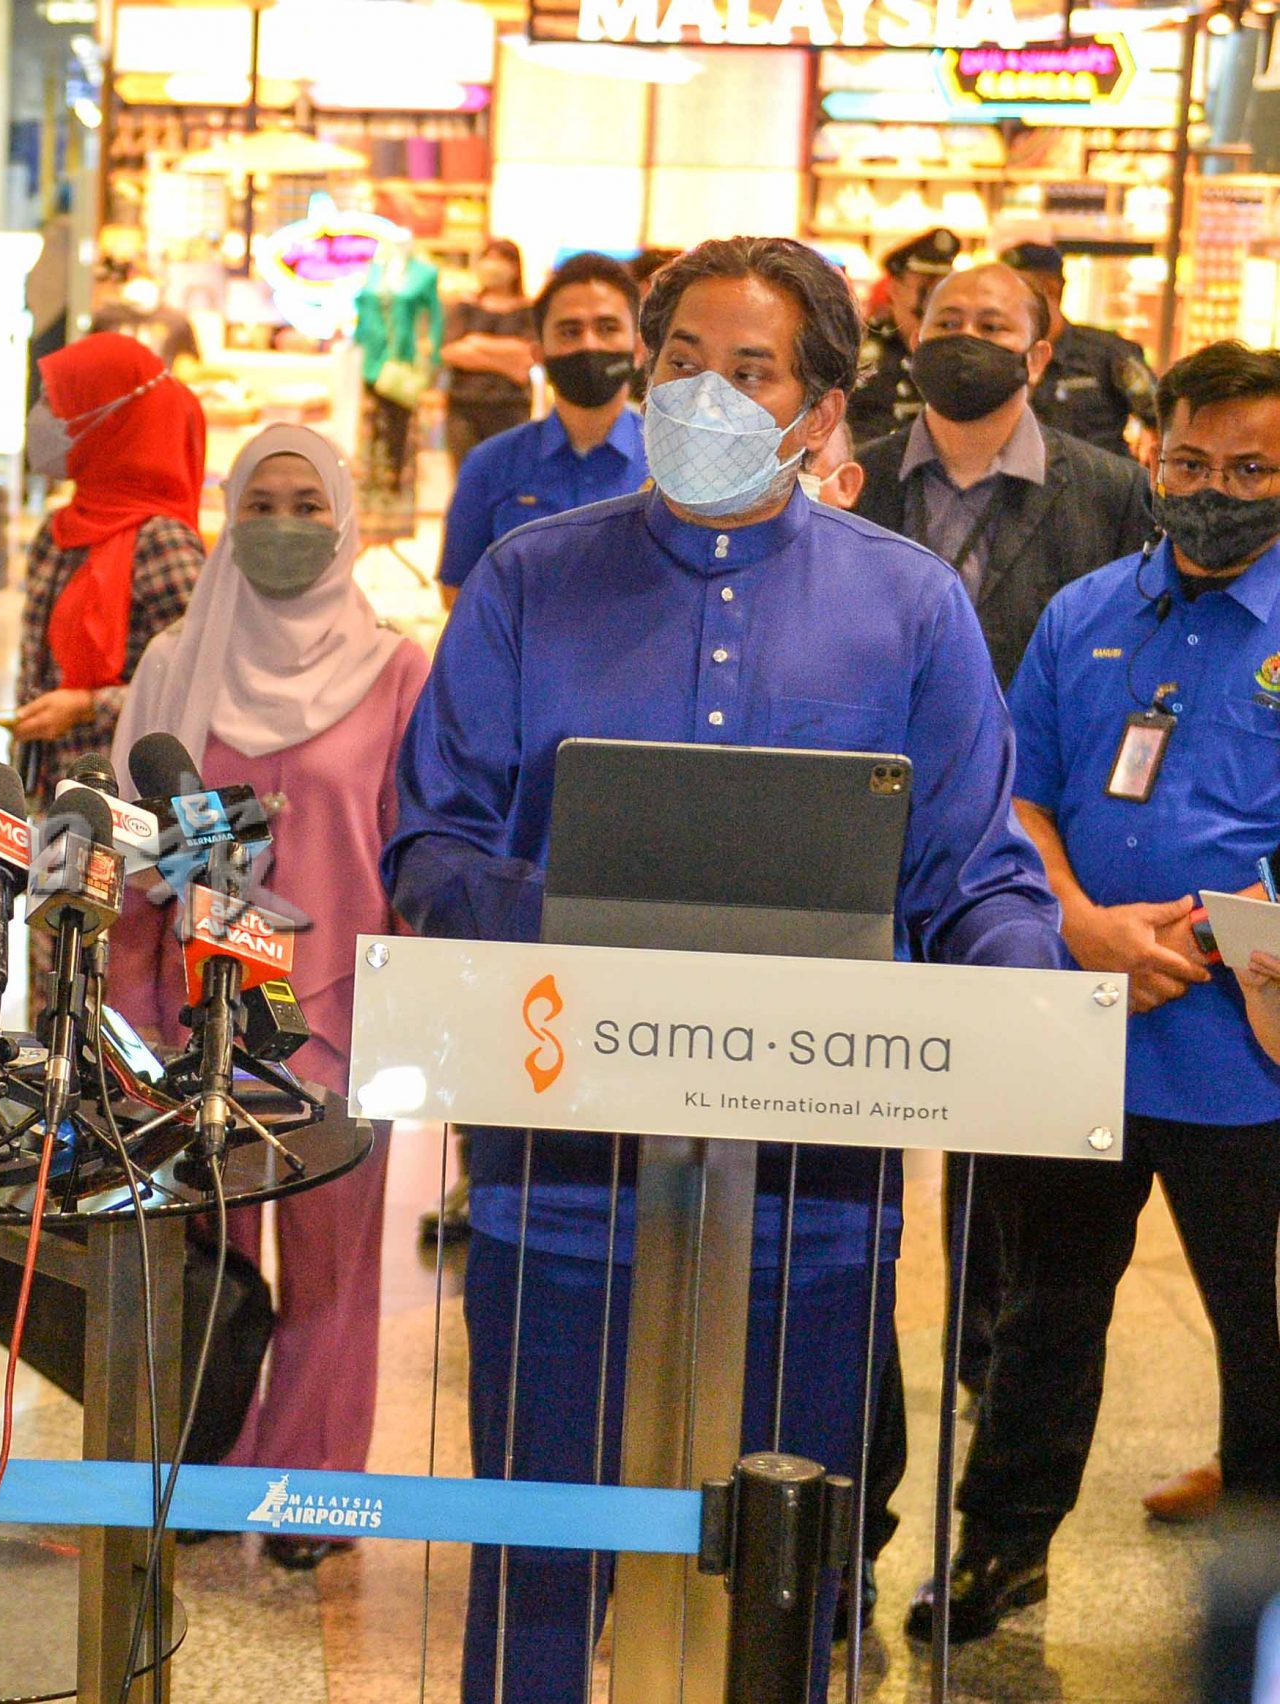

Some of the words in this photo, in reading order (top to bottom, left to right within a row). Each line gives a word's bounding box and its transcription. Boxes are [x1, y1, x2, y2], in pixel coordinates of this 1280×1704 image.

[577, 0, 1026, 47] MALAYSIA
[185, 832, 236, 847] BERNAMA
[210, 901, 274, 936] astro
[195, 917, 284, 960] AWANI
[593, 1019, 754, 1062] sama
[789, 1029, 952, 1073] sama
[684, 1092, 712, 1108] KL
[720, 1094, 861, 1116] International
[869, 1101, 950, 1122] Airport
[281, 1506, 383, 1529] AIRPORTS
[288, 1493, 383, 1511] MALAYSIA
